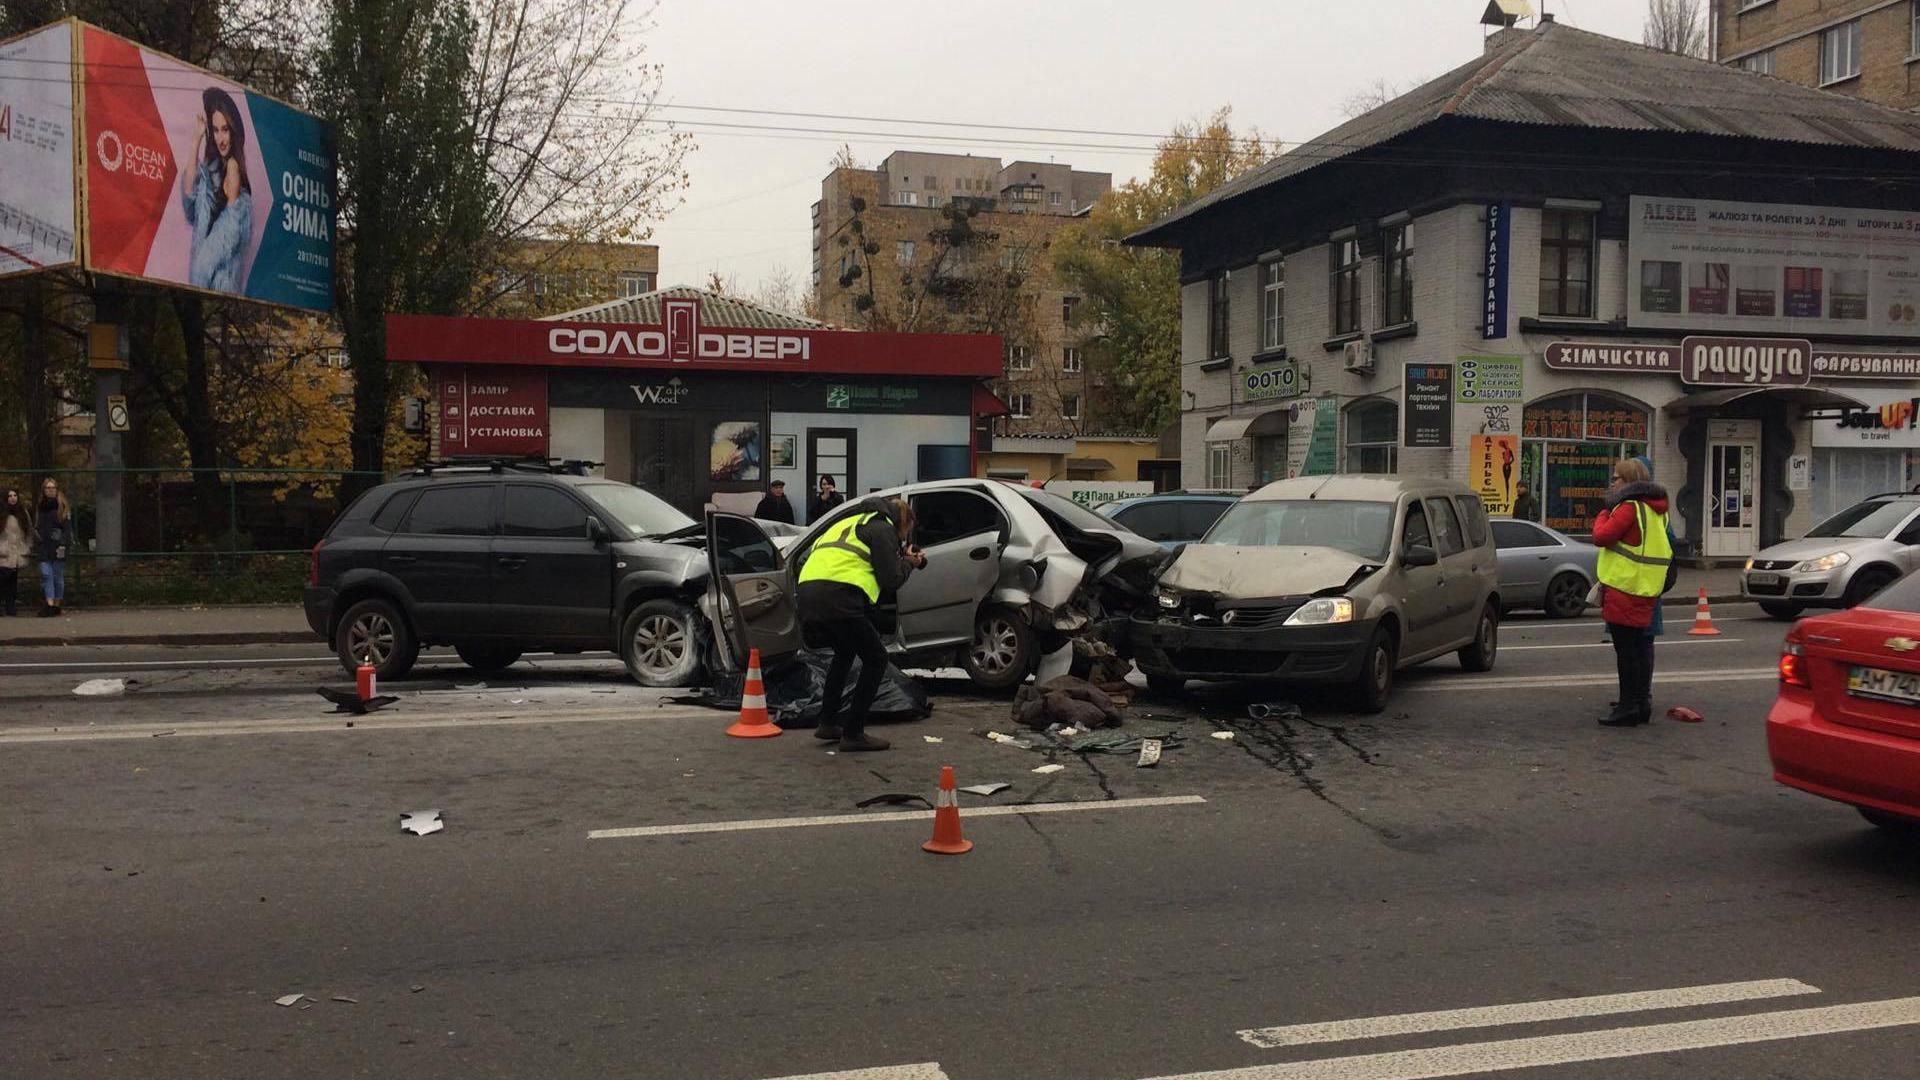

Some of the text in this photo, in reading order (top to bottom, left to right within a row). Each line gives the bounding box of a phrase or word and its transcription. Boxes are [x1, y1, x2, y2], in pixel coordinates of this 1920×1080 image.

[125, 143, 166, 167] OCEAN
[126, 158, 164, 182] PLAZA
[282, 171, 330, 209] ОСІНЬ
[282, 202, 329, 242] ЗИМА
[1643, 203, 1697, 222] ALSER
[1765, 214, 1802, 225] РОЛЕТИ
[1818, 215, 1826, 226] 2
[1487, 205, 1498, 336] СТРАХУВАННЯ
[549, 328, 666, 356] СОЛО
[1560, 347, 1670, 367] ХІМЧИСТКА
[1247, 368, 1295, 390] ФОТО
[1416, 384, 1440, 393] Ремонт
[1461, 361, 1478, 398] ФОТО
[471, 386, 509, 395] ЗАМІР
[1478, 390, 1522, 398] ЛАБОРАТОРІЯ
[470, 406, 536, 417] ДОСТАВКА
[470, 427, 543, 437] УСТАНОВКА
[1524, 420, 1647, 439] ХІМЧИСТКА
[1861, 431, 1890, 440] to travel
[1484, 436, 1493, 486] АТЕЛЬЄ
